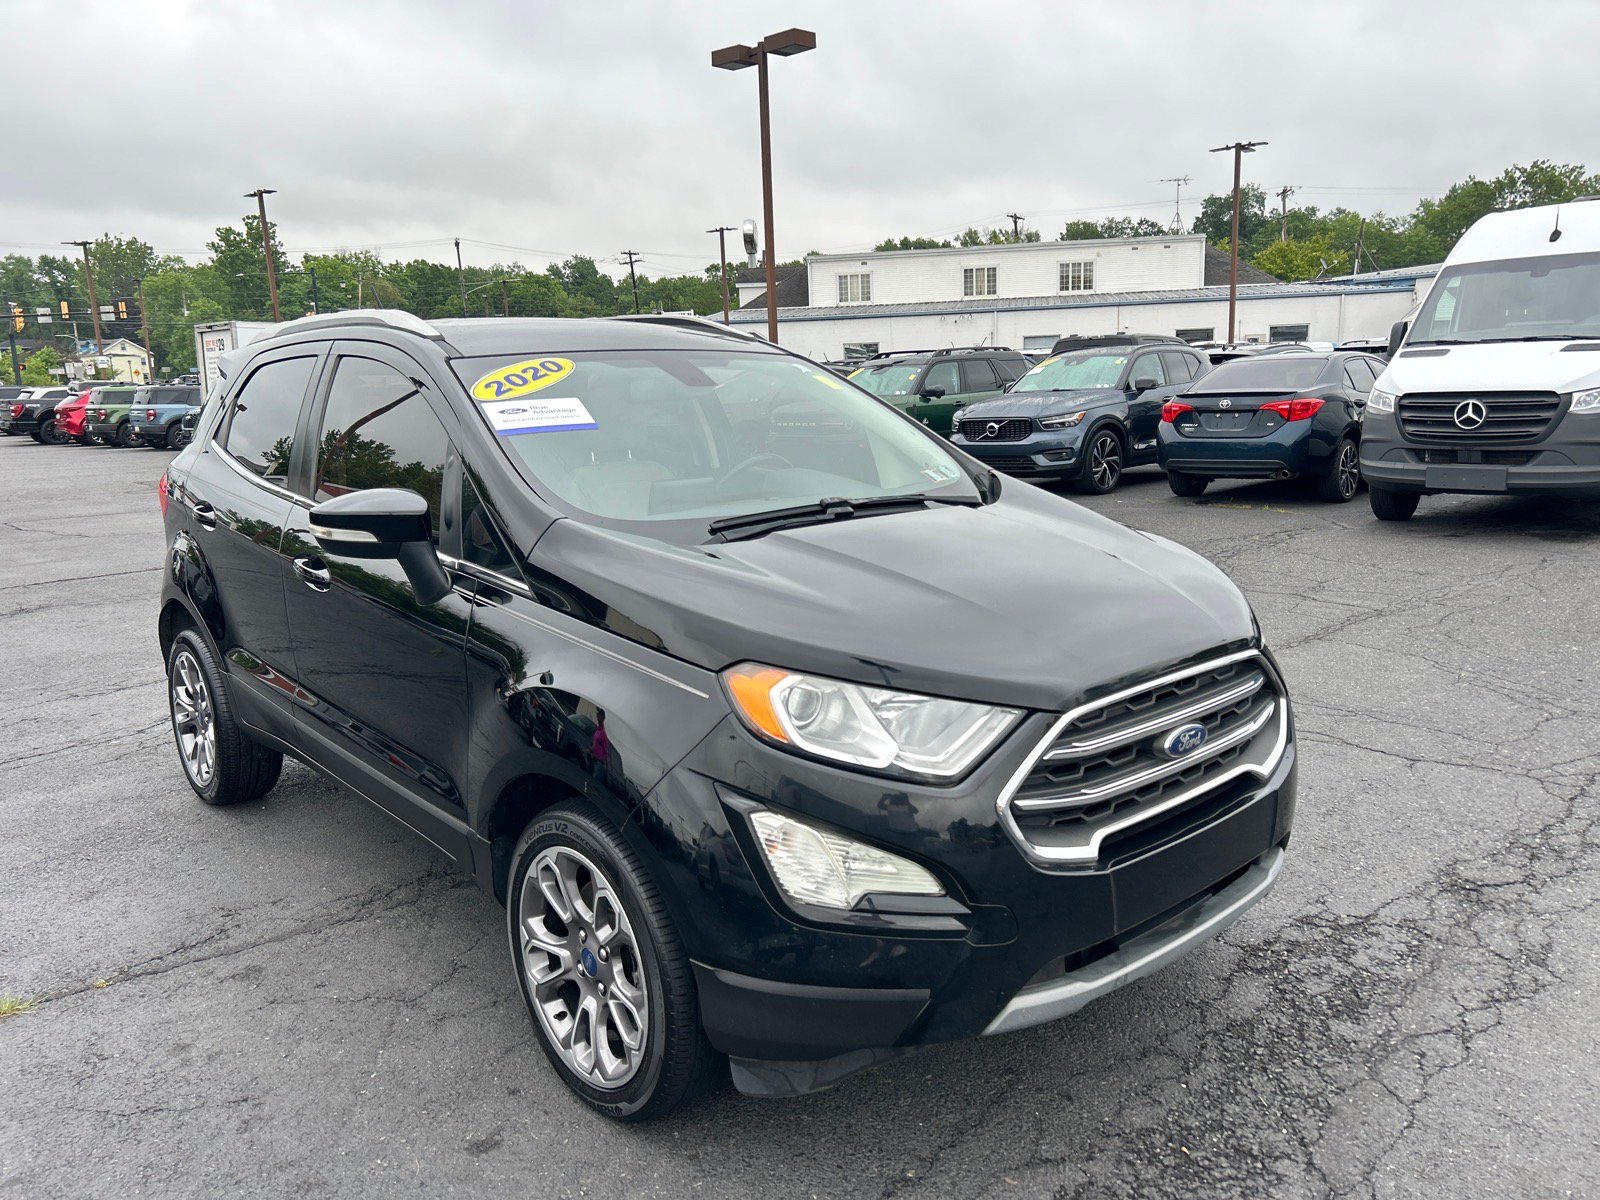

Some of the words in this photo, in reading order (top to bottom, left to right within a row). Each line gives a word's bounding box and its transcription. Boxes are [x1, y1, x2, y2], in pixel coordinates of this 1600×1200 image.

[484, 360, 565, 397] 2020
[532, 407, 577, 415] Advantage
[1178, 730, 1202, 752] Ford
[554, 822, 568, 834] V2
